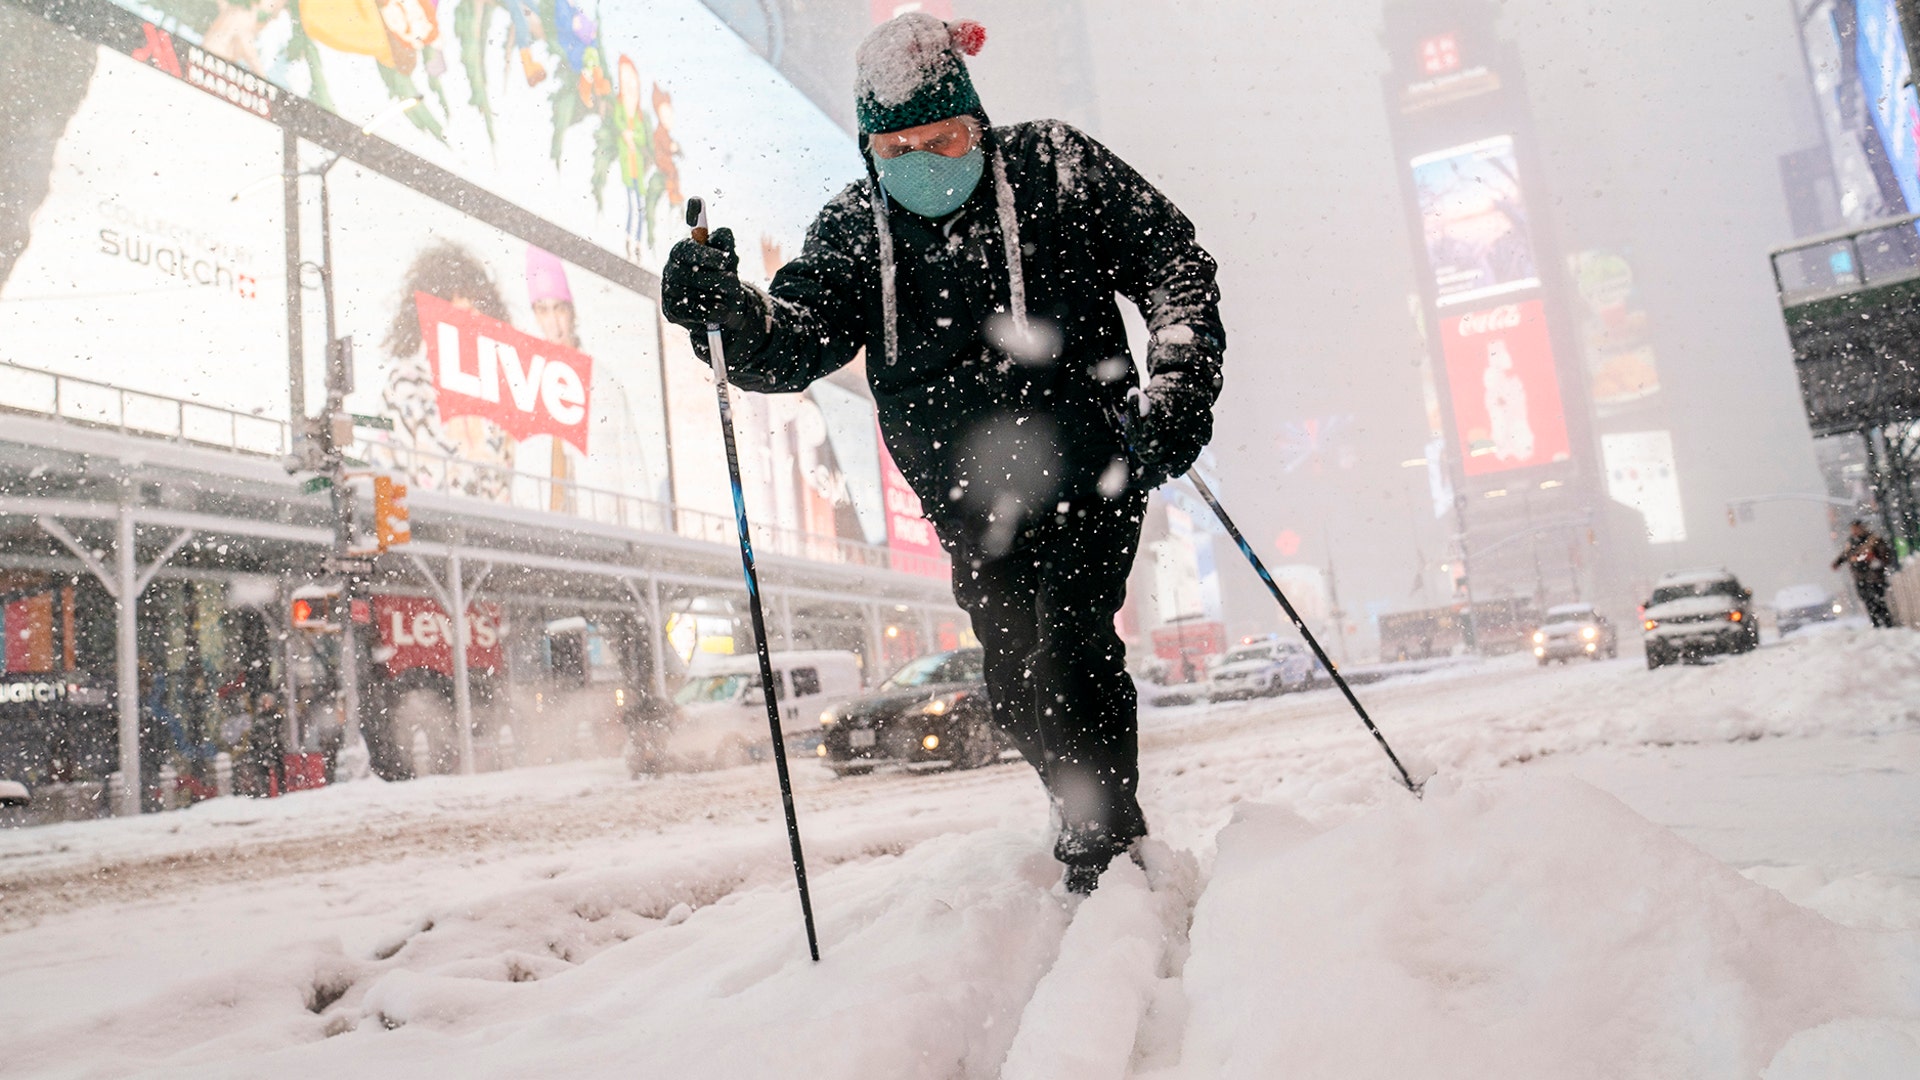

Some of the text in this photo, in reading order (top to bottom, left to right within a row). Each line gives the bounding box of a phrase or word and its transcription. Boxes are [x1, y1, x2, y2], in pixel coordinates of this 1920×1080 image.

[188, 46, 278, 101] MARRIOTT
[188, 64, 270, 116] MARQUIS
[100, 229, 234, 291] swatch
